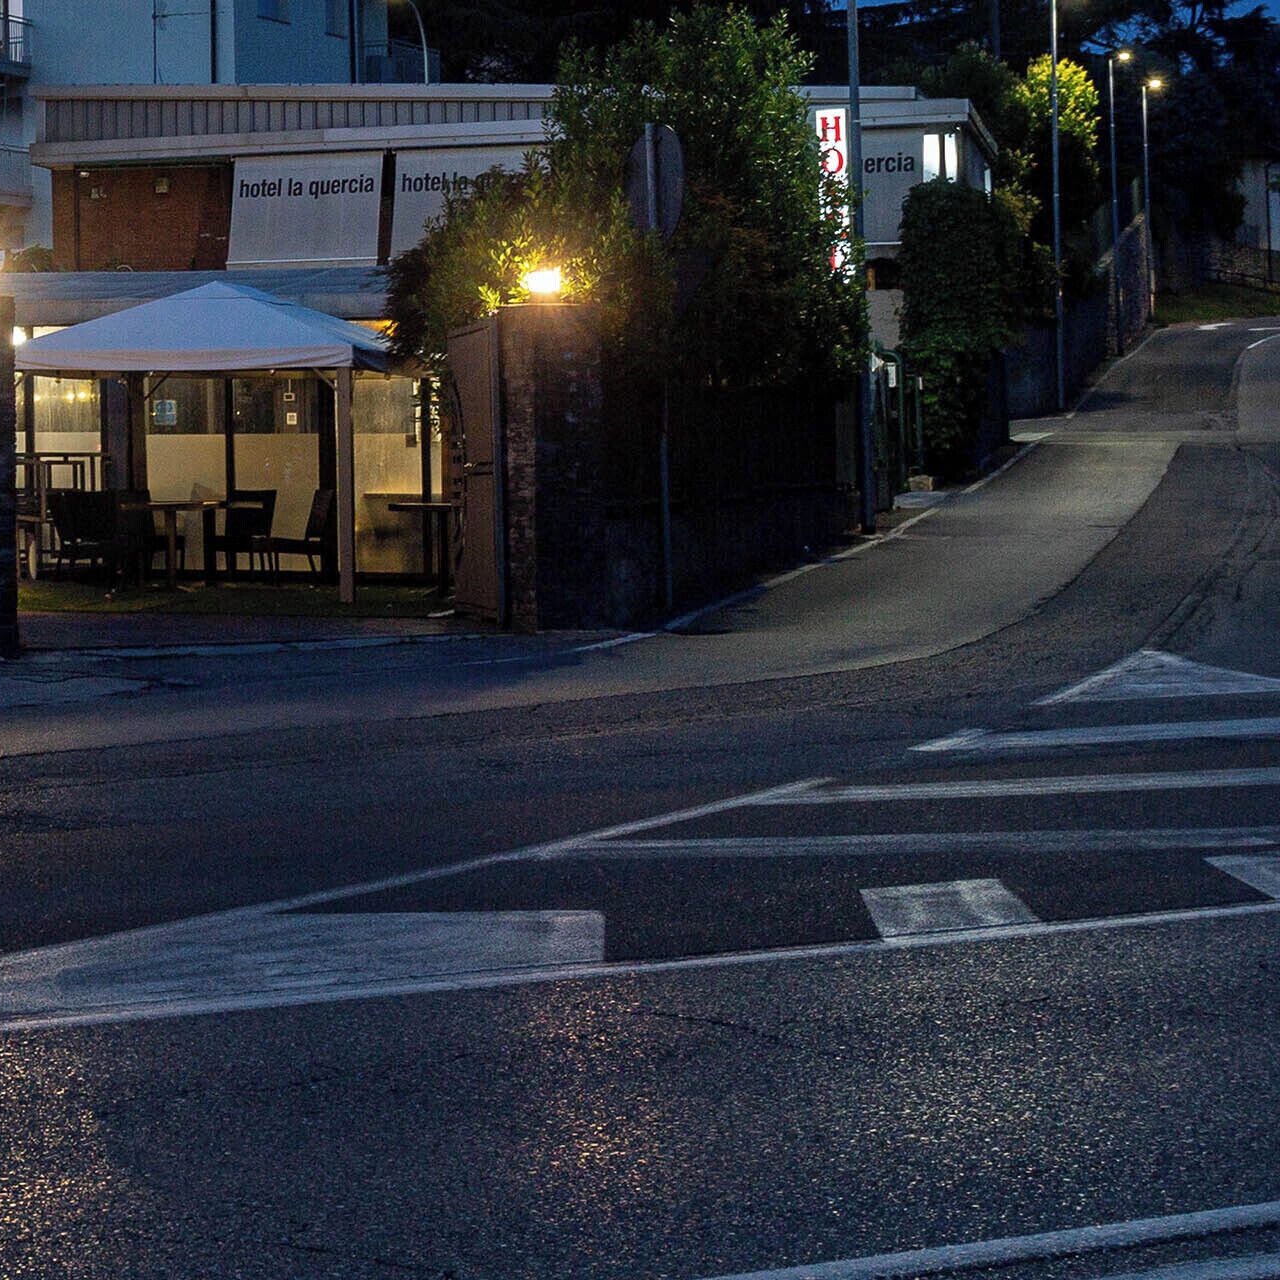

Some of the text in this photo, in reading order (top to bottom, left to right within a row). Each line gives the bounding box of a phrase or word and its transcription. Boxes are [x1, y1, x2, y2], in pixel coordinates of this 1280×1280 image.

[861, 152, 916, 174] ercia
[239, 174, 375, 200] hotel la quercia
